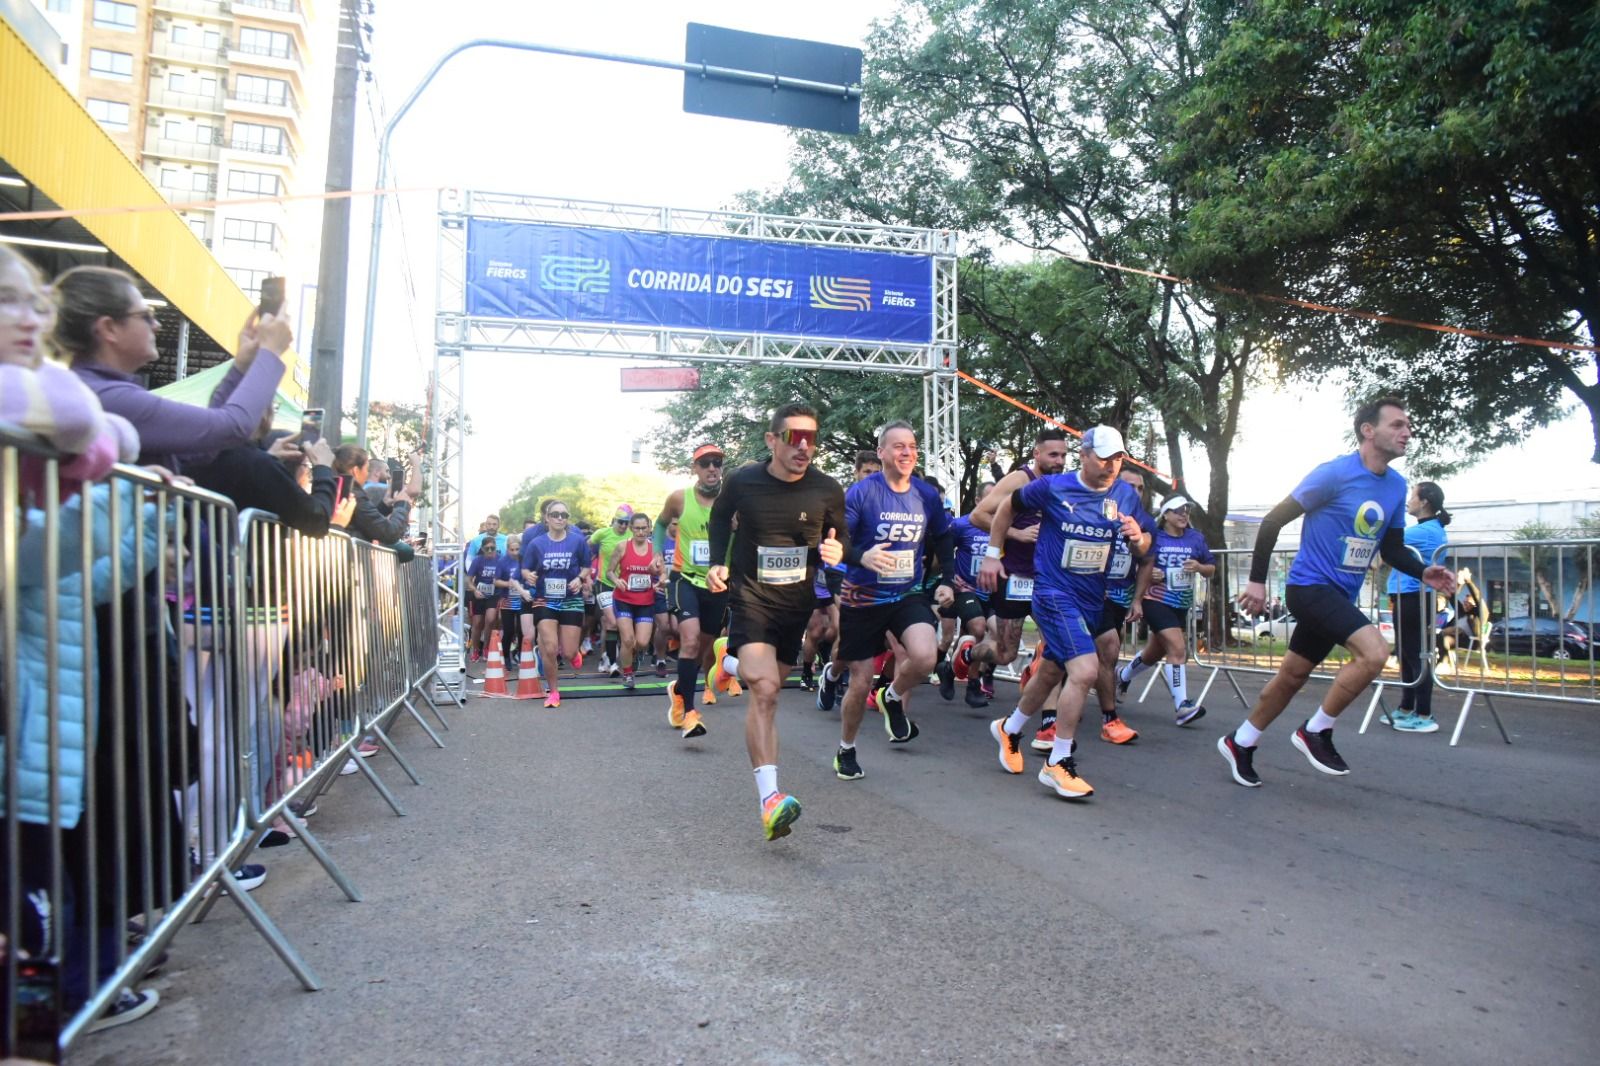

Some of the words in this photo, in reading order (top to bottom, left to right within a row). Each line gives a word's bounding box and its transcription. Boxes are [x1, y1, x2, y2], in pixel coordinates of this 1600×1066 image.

[627, 268, 712, 293] CORRIDA
[716, 275, 743, 295] DO
[880, 512, 913, 522] CORRIDA
[914, 513, 924, 523] DO
[1061, 522, 1113, 538] MASSA
[1075, 550, 1103, 561] 5179
[1350, 547, 1371, 559] 1003
[767, 557, 800, 568] 5089
